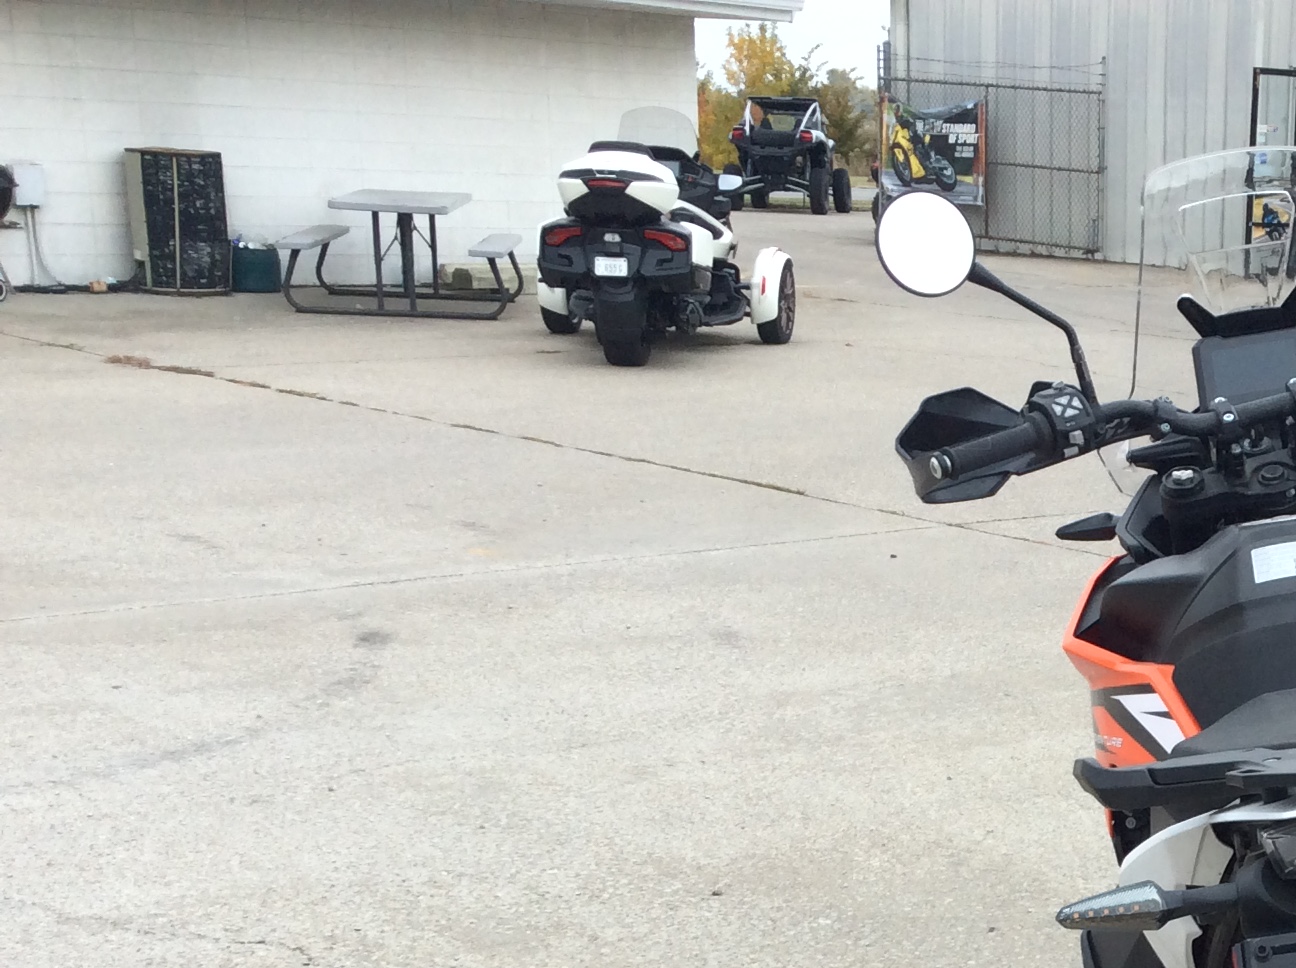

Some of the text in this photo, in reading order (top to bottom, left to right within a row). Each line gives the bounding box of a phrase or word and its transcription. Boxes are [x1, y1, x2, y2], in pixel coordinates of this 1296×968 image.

[942, 123, 976, 133] STANDARD
[948, 133, 979, 144] OF SPORT
